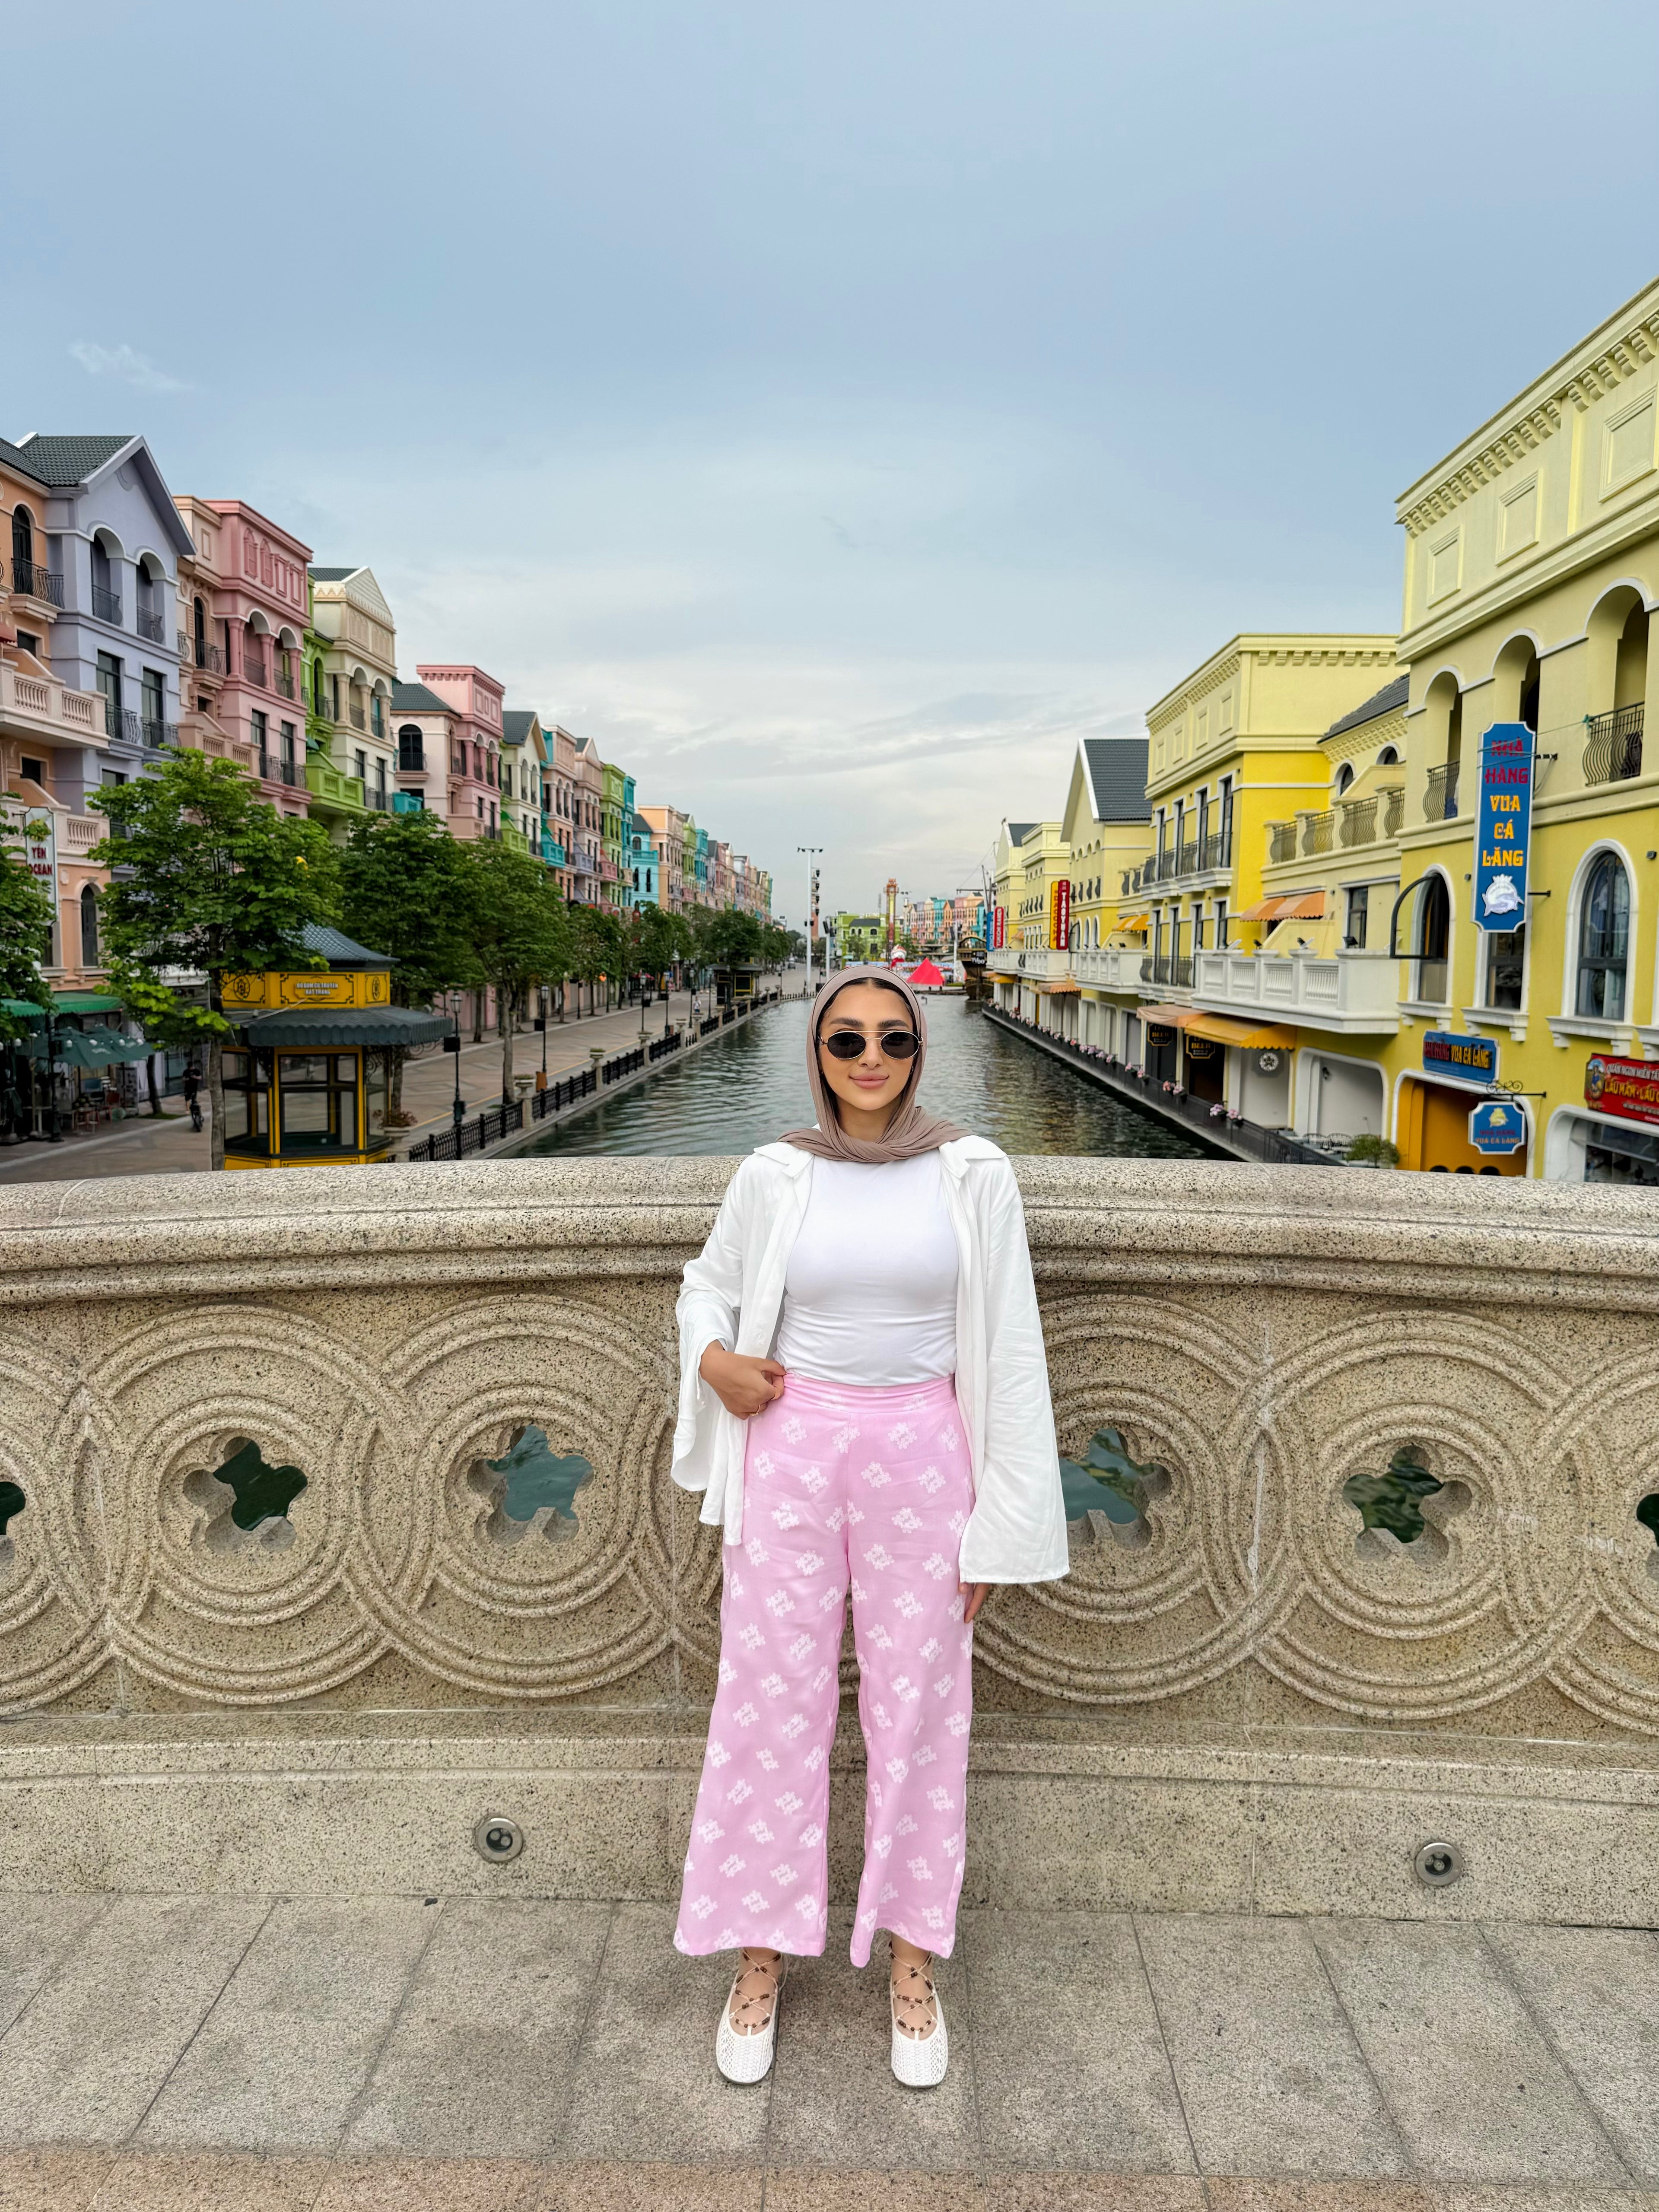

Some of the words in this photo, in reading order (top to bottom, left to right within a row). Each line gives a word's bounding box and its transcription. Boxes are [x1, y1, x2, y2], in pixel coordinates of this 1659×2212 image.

[1484, 764, 1528, 784] HÀNG
[1490, 795, 1521, 812] VUA
[1494, 819, 1514, 839] CÁ
[1482, 846, 1523, 866] LĂNG
[1451, 1045, 1462, 1063] VUA
